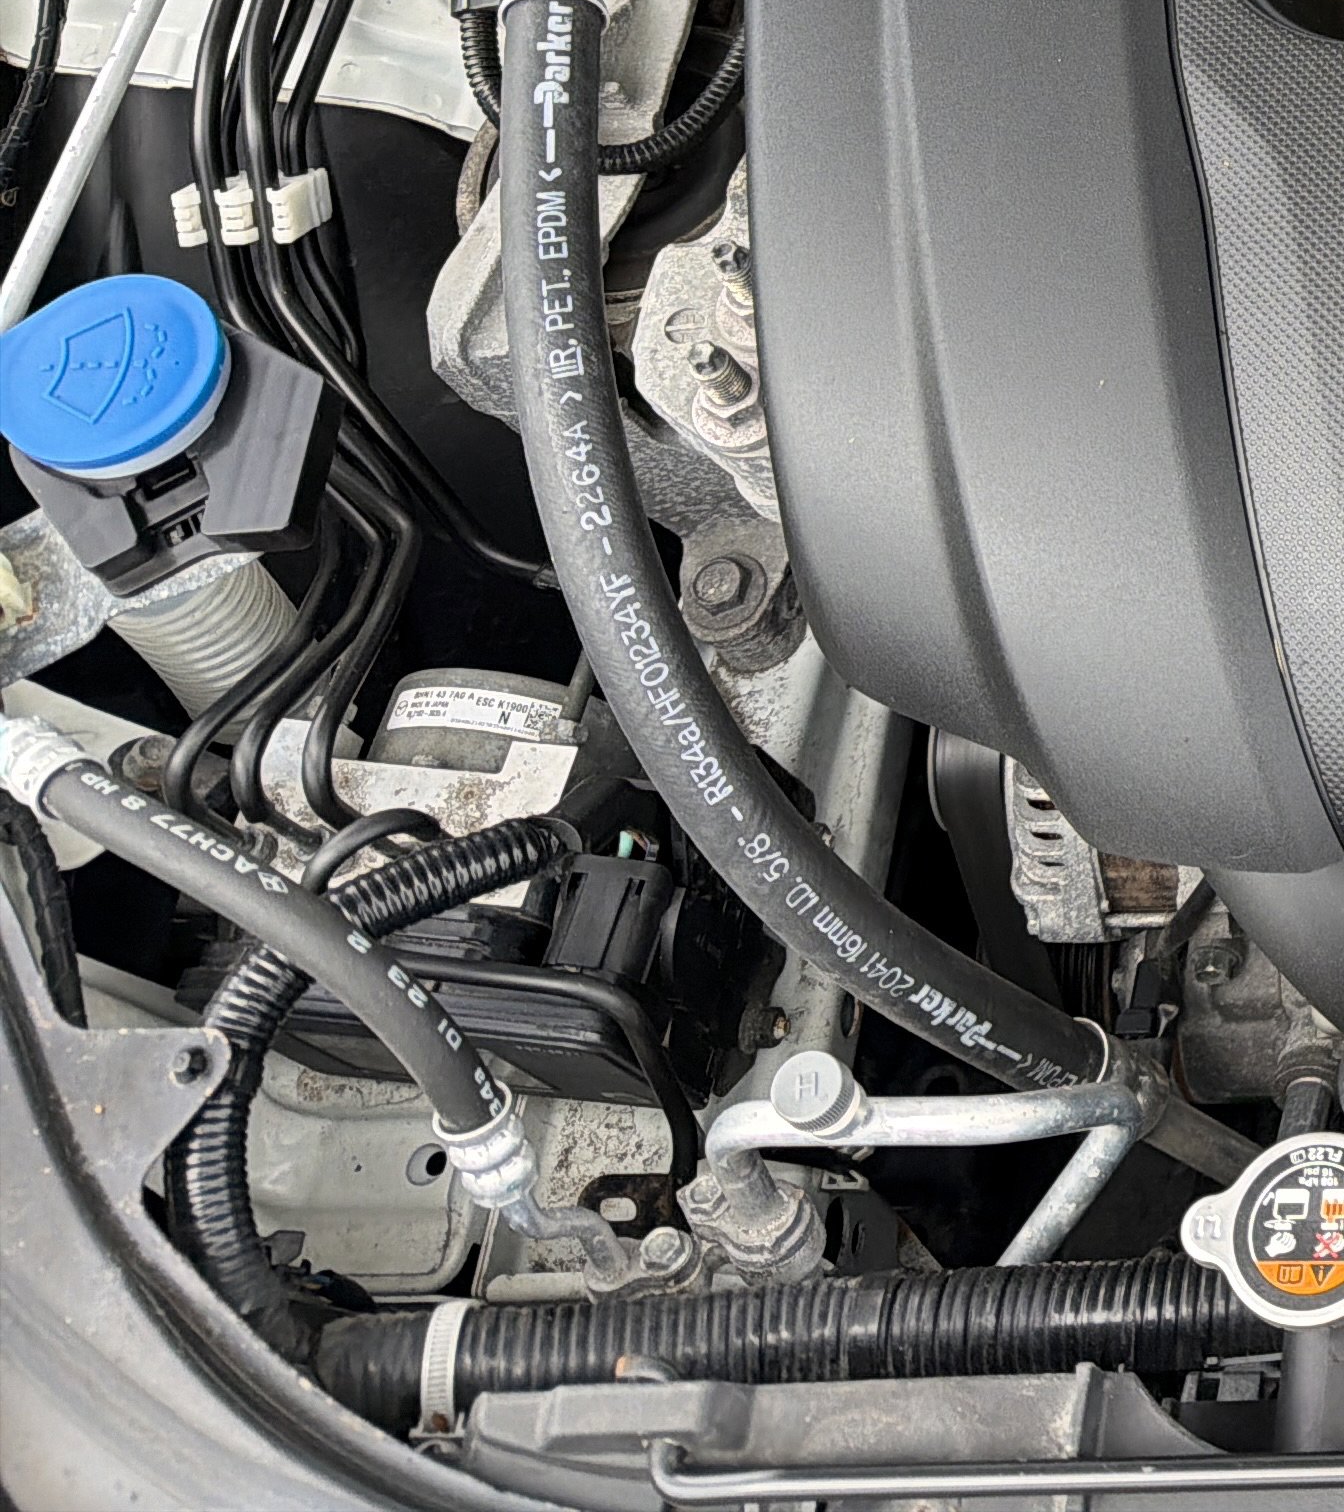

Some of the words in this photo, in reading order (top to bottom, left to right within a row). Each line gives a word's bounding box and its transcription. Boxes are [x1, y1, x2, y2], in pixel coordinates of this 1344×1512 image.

[534, 1, 573, 105] Parker
[537, 190, 568, 259] EPDM
[559, 420, 614, 533] 2264A
[476, 696, 496, 708] ESC
[498, 700, 529, 714] K1900
[498, 711, 511, 725] N
[79, 766, 121, 799] HP
[120, 790, 148, 814] 8
[776, 875, 822, 916] I.D.
[808, 905, 870, 965] 16mm
[858, 949, 917, 1001] 2041
[906, 979, 993, 1049] Parker
[468, 1066, 503, 1117] 34a
[794, 1071, 821, 1101] H
[1303, 1167, 1320, 1176] psi
[1307, 1148, 1343, 1162] FL22
[1298, 1177, 1318, 1187] kPa
